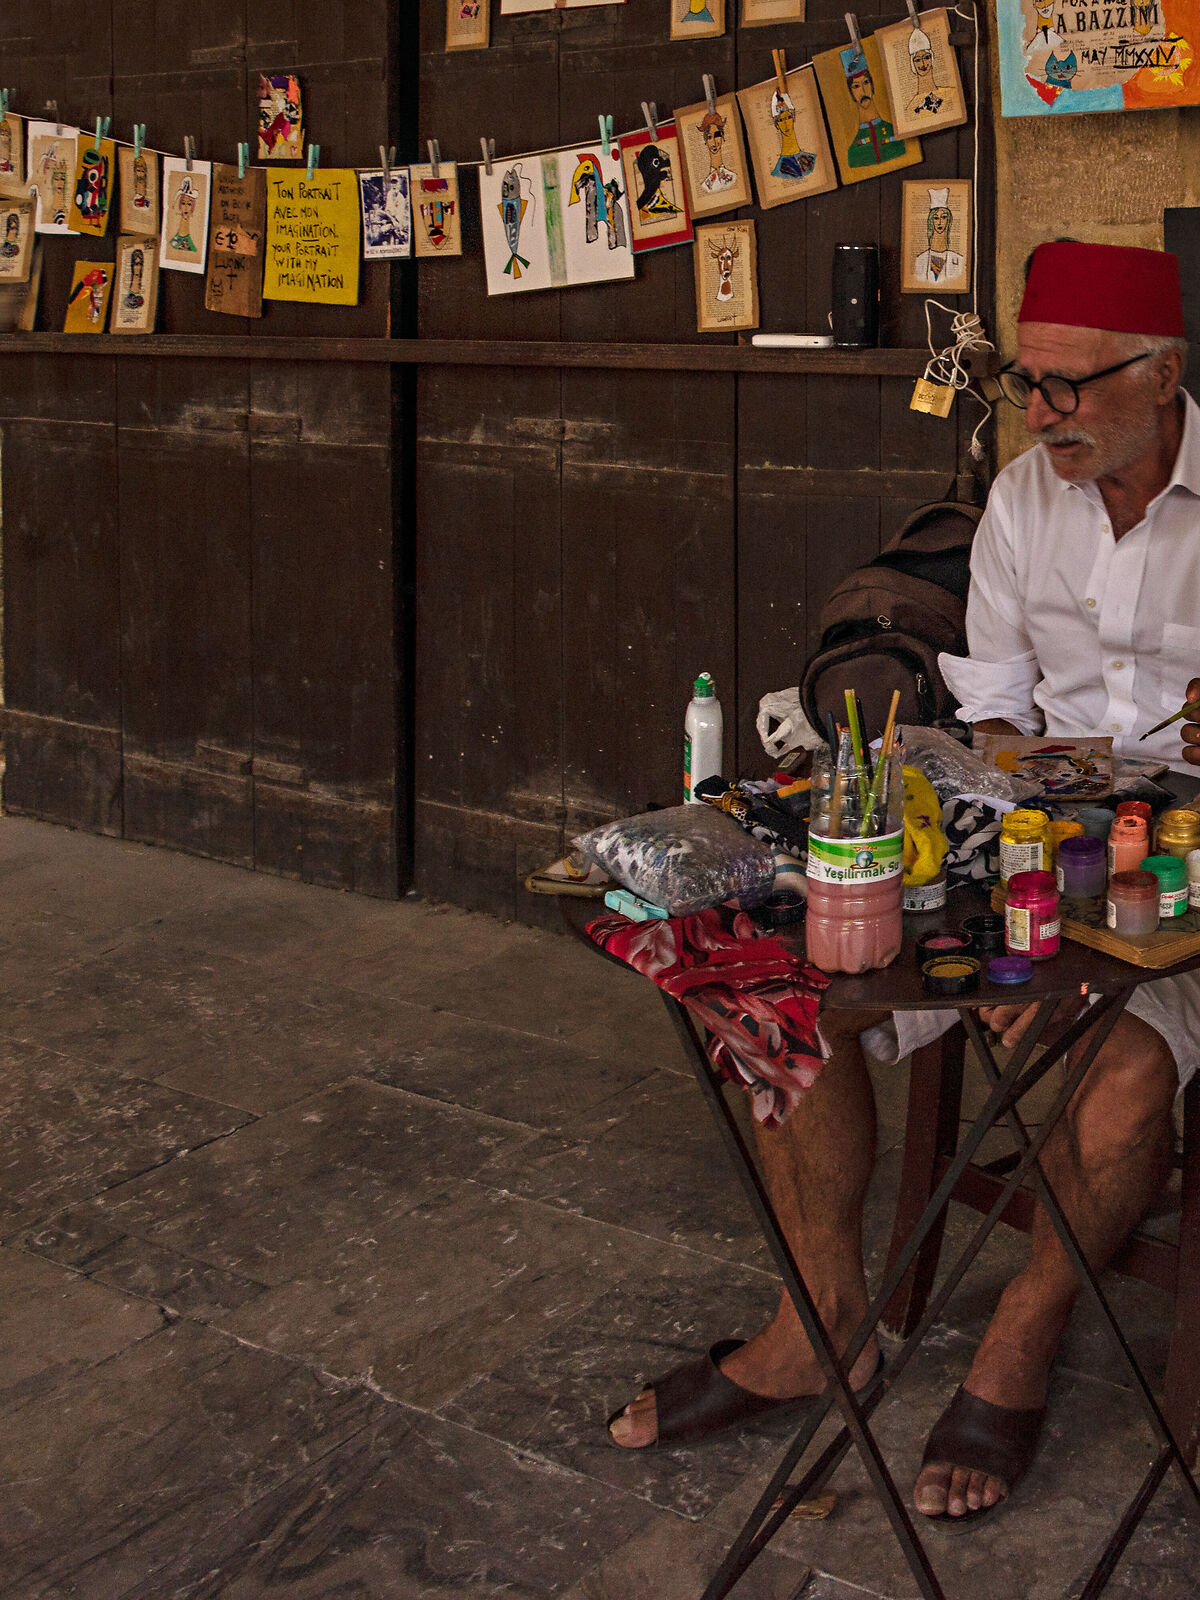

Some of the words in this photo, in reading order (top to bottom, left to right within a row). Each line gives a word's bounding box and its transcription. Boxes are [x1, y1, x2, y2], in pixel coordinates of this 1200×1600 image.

[1076, 4, 1160, 32] BAZZINI
[1081, 47, 1108, 65] MAY
[1115, 45, 1176, 66] MMXXIV
[273, 205, 298, 219] AVEC
[300, 205, 319, 219] MON
[273, 256, 302, 270] WITH
[305, 258, 318, 272] MY
[888, 860, 900, 873] Su
